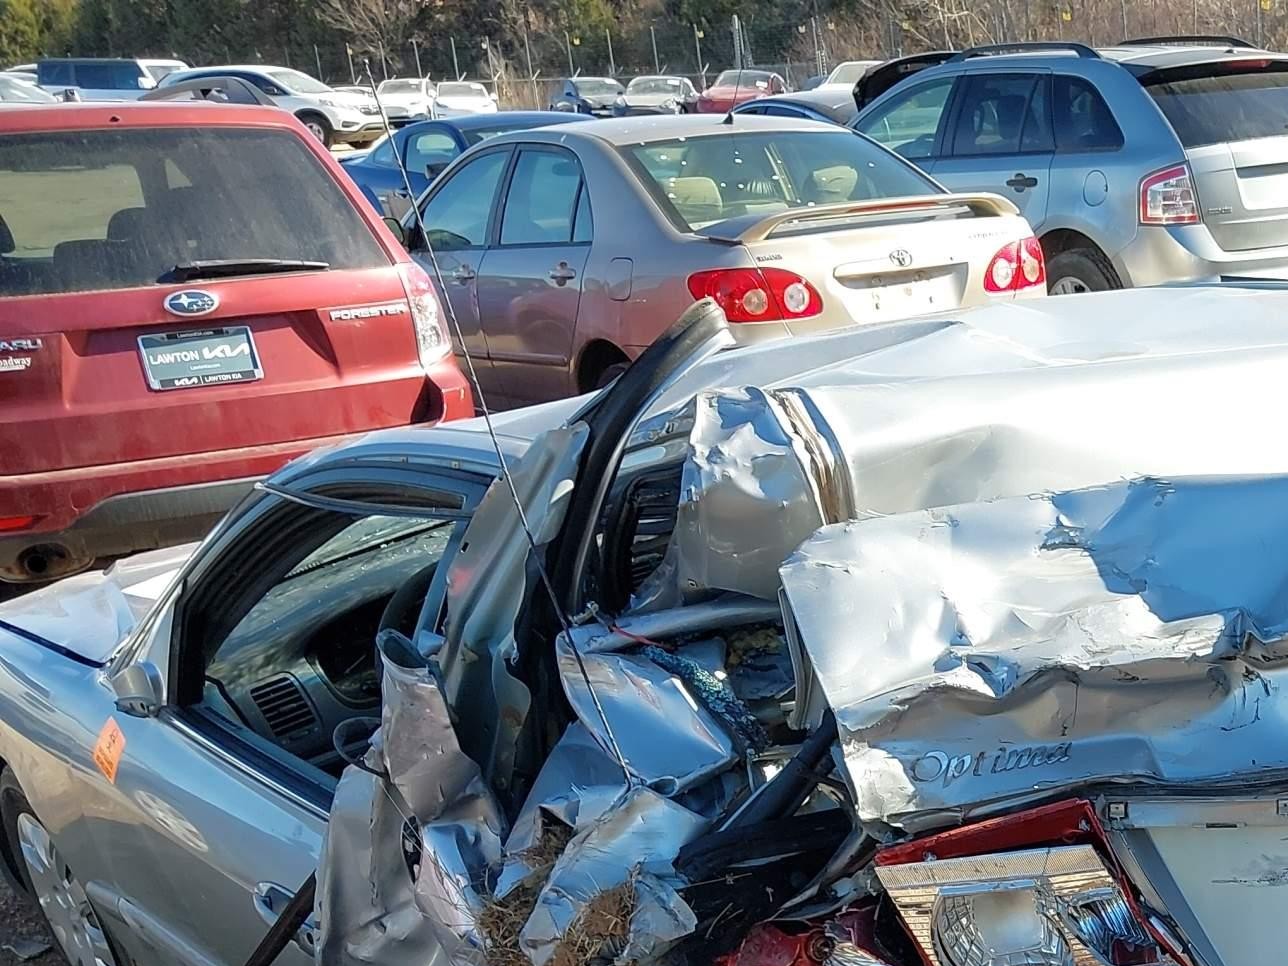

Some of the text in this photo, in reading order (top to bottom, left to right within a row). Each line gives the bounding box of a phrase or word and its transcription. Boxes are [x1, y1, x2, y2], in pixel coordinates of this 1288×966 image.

[329, 303, 406, 321] FORESTER
[149, 342, 251, 365] LAWTON KIA
[204, 373, 231, 383] LAWTON
[911, 742, 1072, 788] Optima
